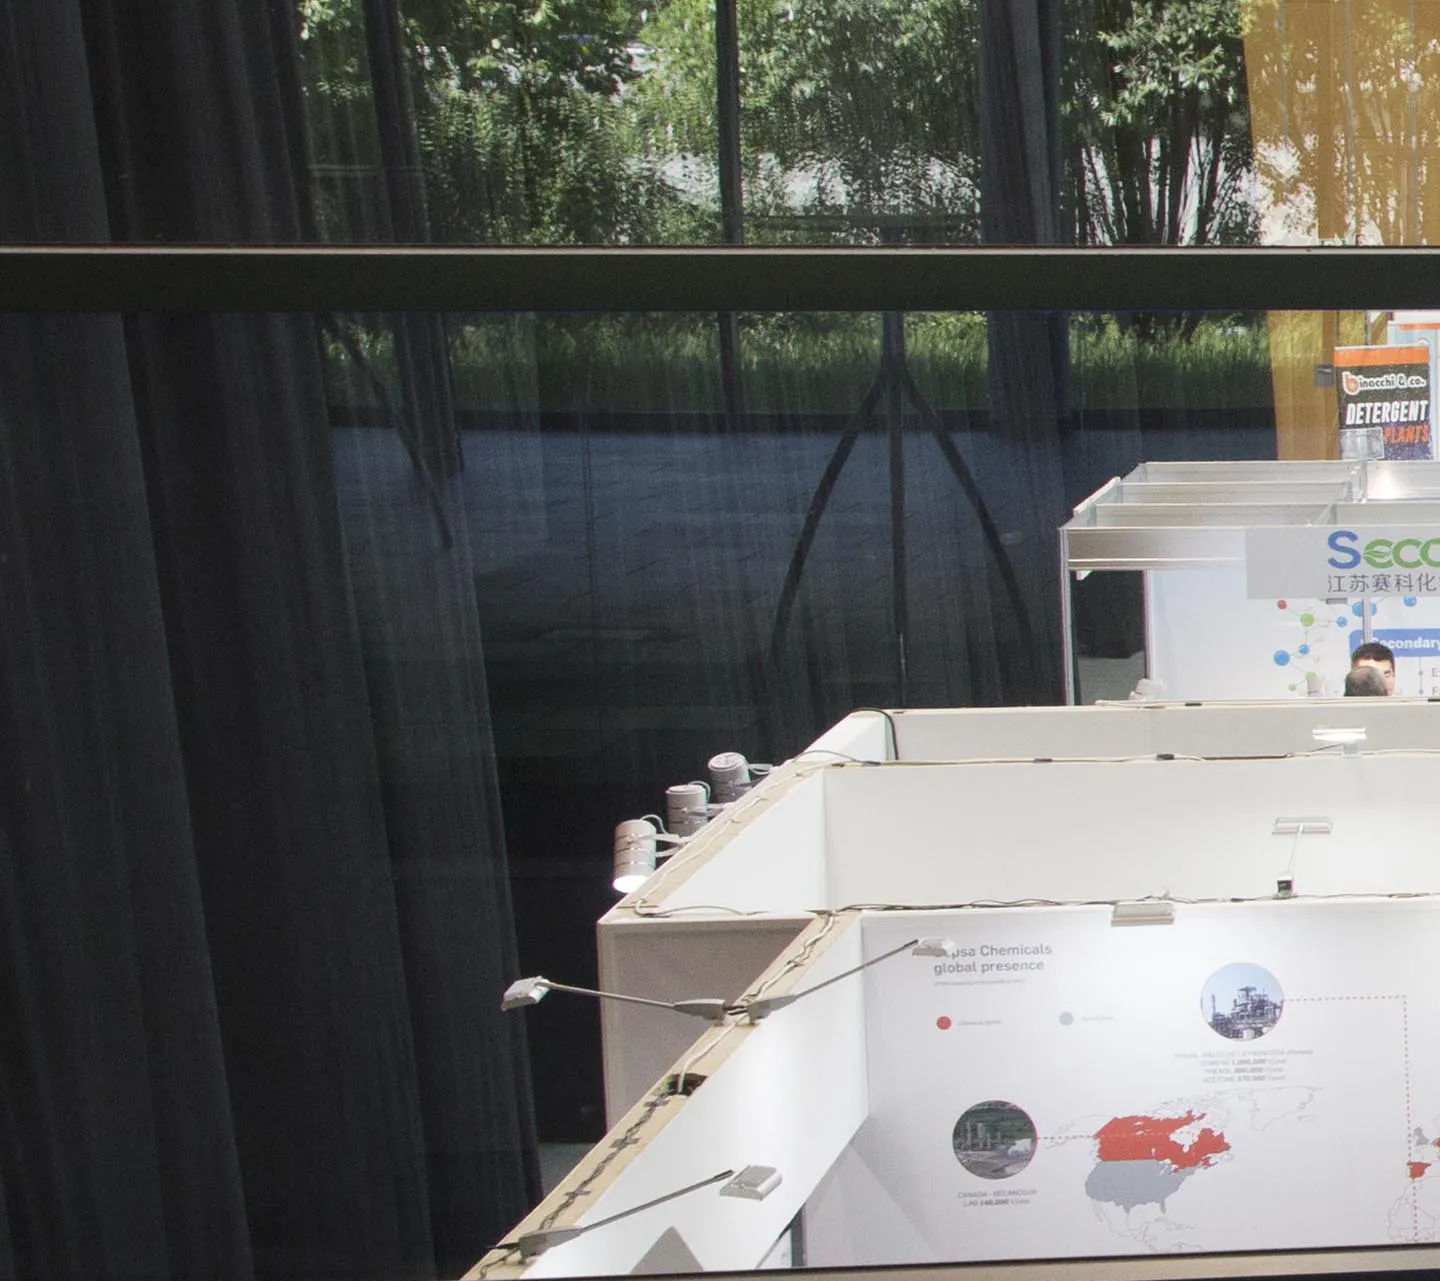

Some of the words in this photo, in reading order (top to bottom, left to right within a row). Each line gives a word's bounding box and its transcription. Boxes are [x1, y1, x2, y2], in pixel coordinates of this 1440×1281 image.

[1346, 400, 1428, 424] DETERGENT
[1384, 425, 1429, 444] PLANTS
[980, 943, 1053, 957] Chemicals
[934, 961, 976, 976] global
[980, 960, 1044, 974] presence
